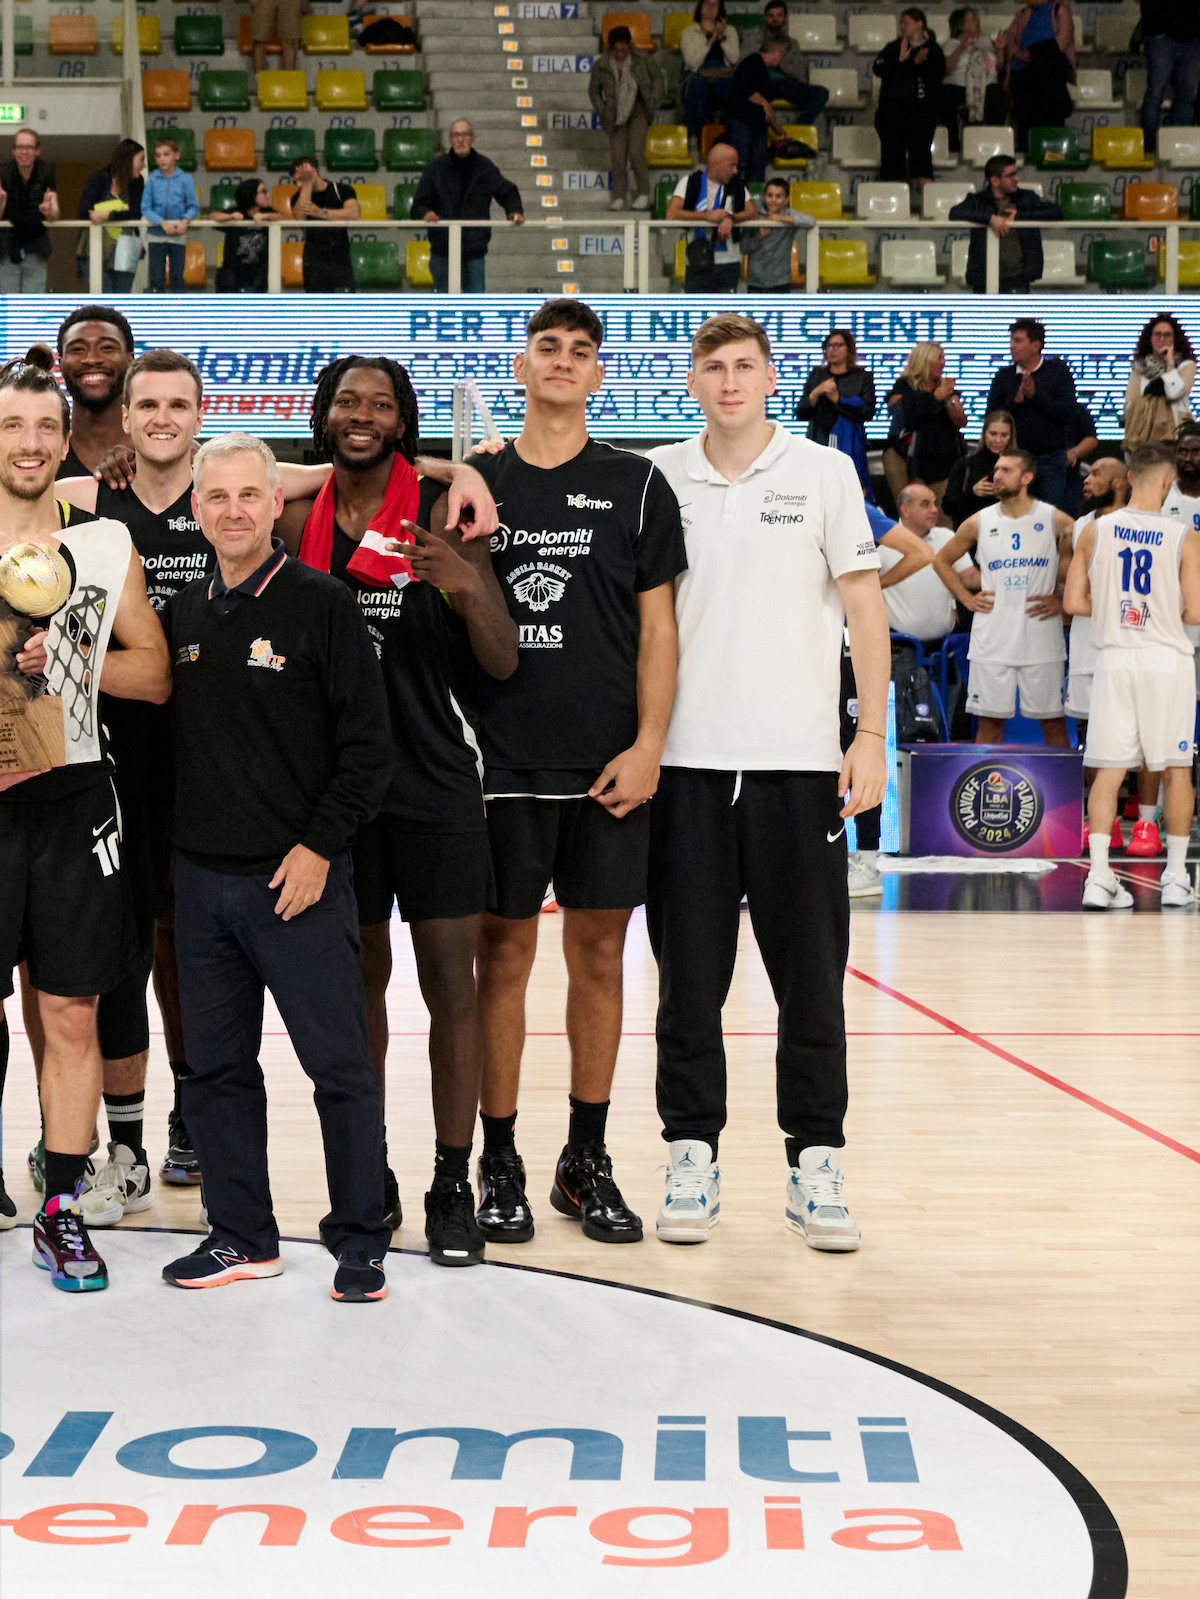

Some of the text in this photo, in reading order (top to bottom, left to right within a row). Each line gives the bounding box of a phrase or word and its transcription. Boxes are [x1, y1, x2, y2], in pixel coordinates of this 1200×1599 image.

[523, 5, 576, 19] FILA 7
[537, 58, 590, 72] FILA 6
[552, 113, 589, 128] FILA
[568, 174, 605, 189] FILA
[584, 238, 624, 253] FILA
[410, 310, 484, 342] PER
[566, 493, 613, 510] TRENTINO
[775, 494, 808, 502] Dolomiti
[167, 515, 201, 531] TRENTI
[760, 512, 804, 525] TRENTINO
[513, 529, 593, 545] Dolomiti
[1011, 533, 1020, 550] 3
[1114, 525, 1164, 546] IVANOVIC
[538, 544, 590, 557] energia
[1003, 557, 1049, 569] GERMANI
[155, 568, 205, 582] energia
[506, 562, 572, 584] AQUILA BASKET
[1118, 547, 1153, 595] 18
[1004, 575, 1029, 586] a2a
[357, 590, 404, 605] lomiti
[362, 606, 401, 619] nergia
[518, 625, 563, 643] ITAS
[959, 777, 981, 830] PLAYOFF
[985, 794, 1008, 804] LBA
[1013, 780, 1034, 833] PLAYOFF
[978, 827, 1011, 842] 2024
